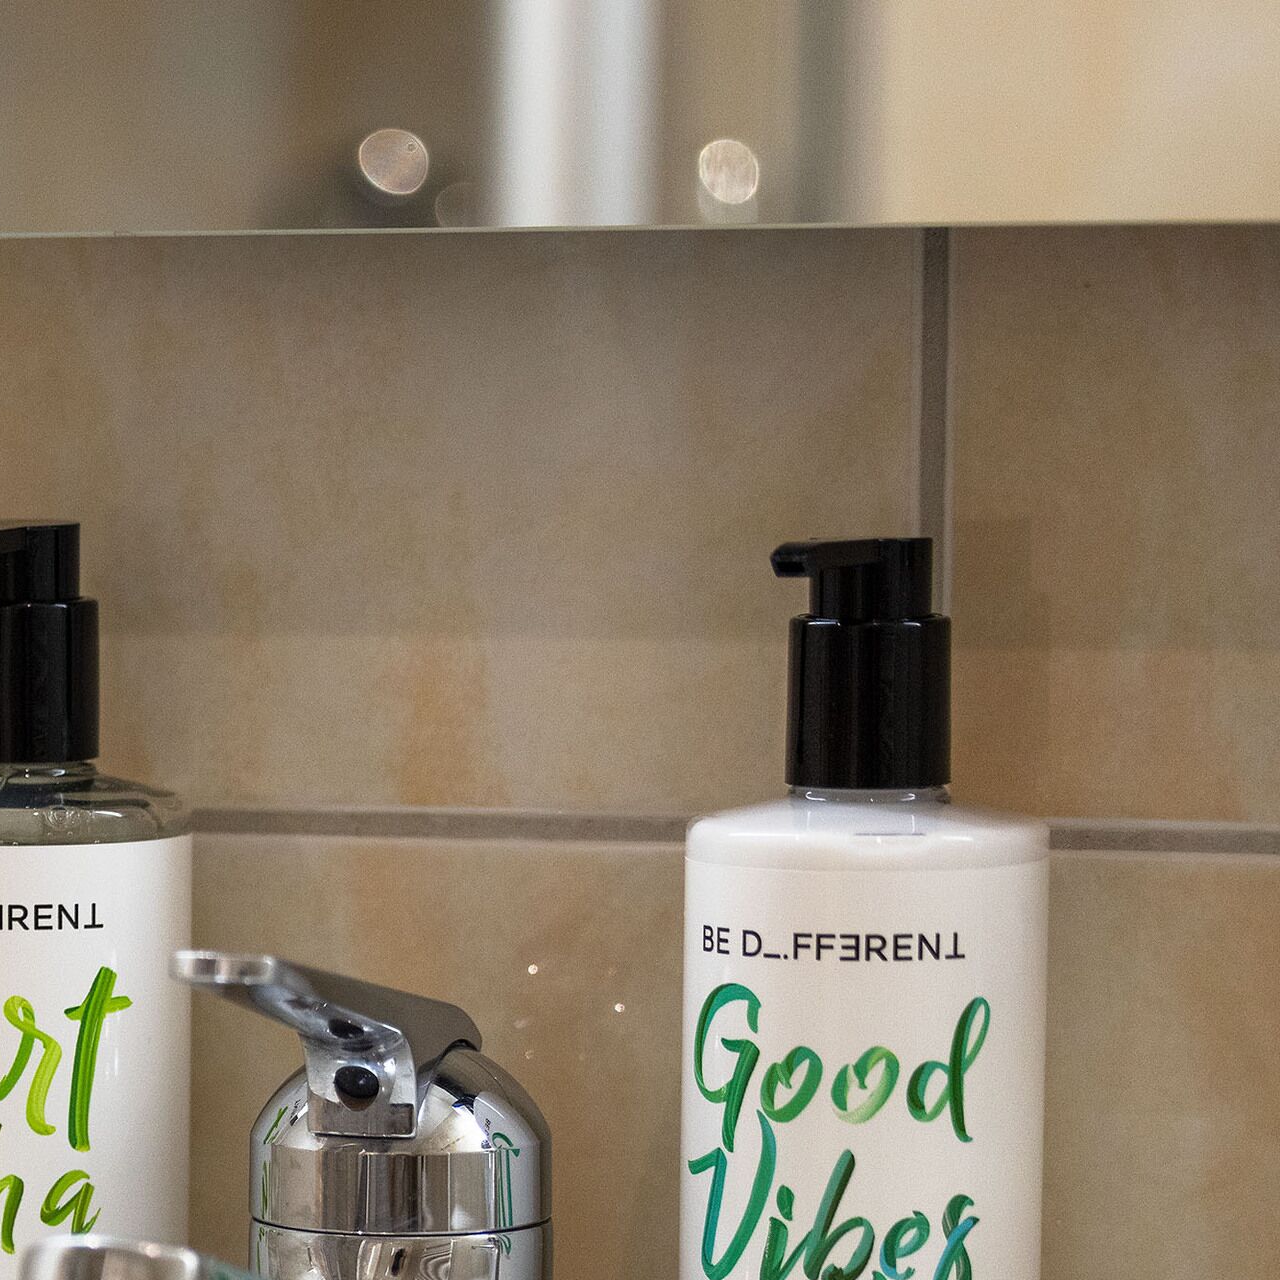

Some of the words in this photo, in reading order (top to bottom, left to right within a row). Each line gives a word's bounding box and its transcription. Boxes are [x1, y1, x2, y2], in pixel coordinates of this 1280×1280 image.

[701, 924, 731, 956] BE
[693, 983, 991, 1153] Good
[40, 1169, 102, 1236] a
